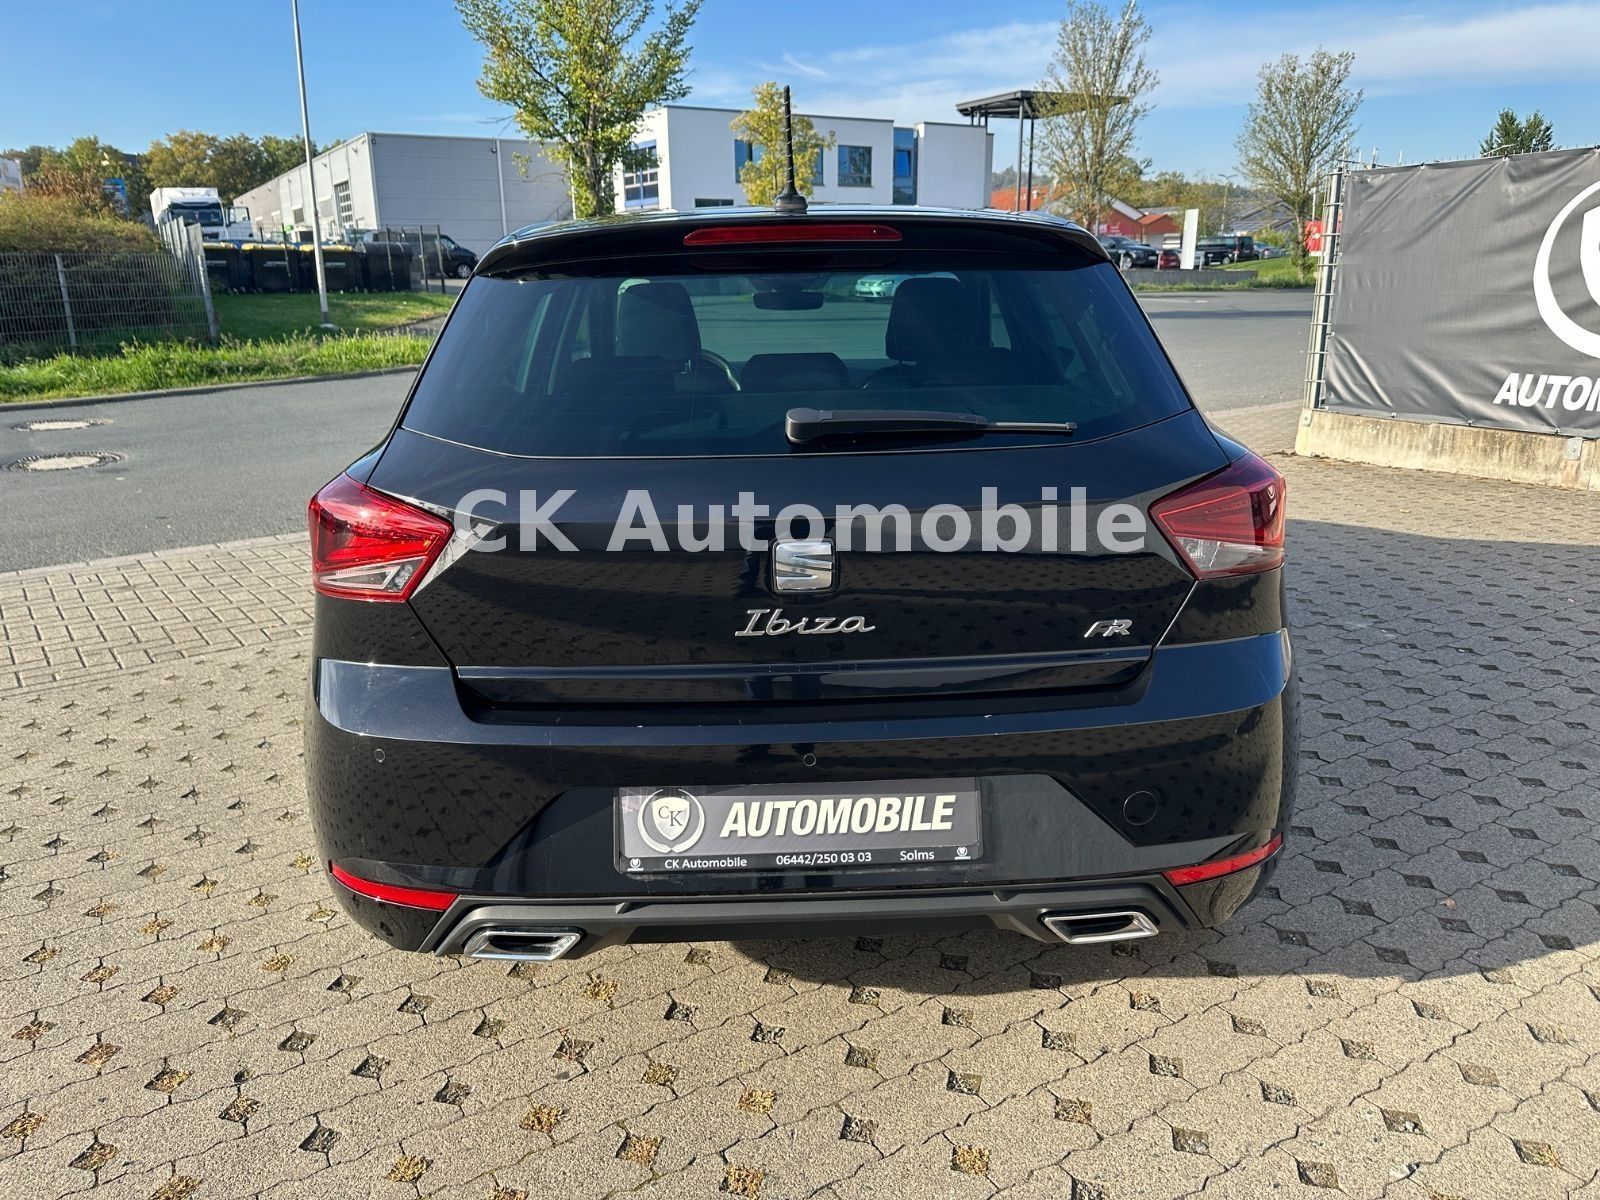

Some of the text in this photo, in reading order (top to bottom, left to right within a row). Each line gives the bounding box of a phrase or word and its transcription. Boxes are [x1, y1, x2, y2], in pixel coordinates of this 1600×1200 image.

[735, 608, 876, 637] Ibiza
[1083, 619, 1133, 638] FR
[658, 805, 684, 827] CK
[719, 794, 956, 838] AUTOMOBILE
[664, 849, 935, 869] CK Automobile 06442/250 03 03 Solms
